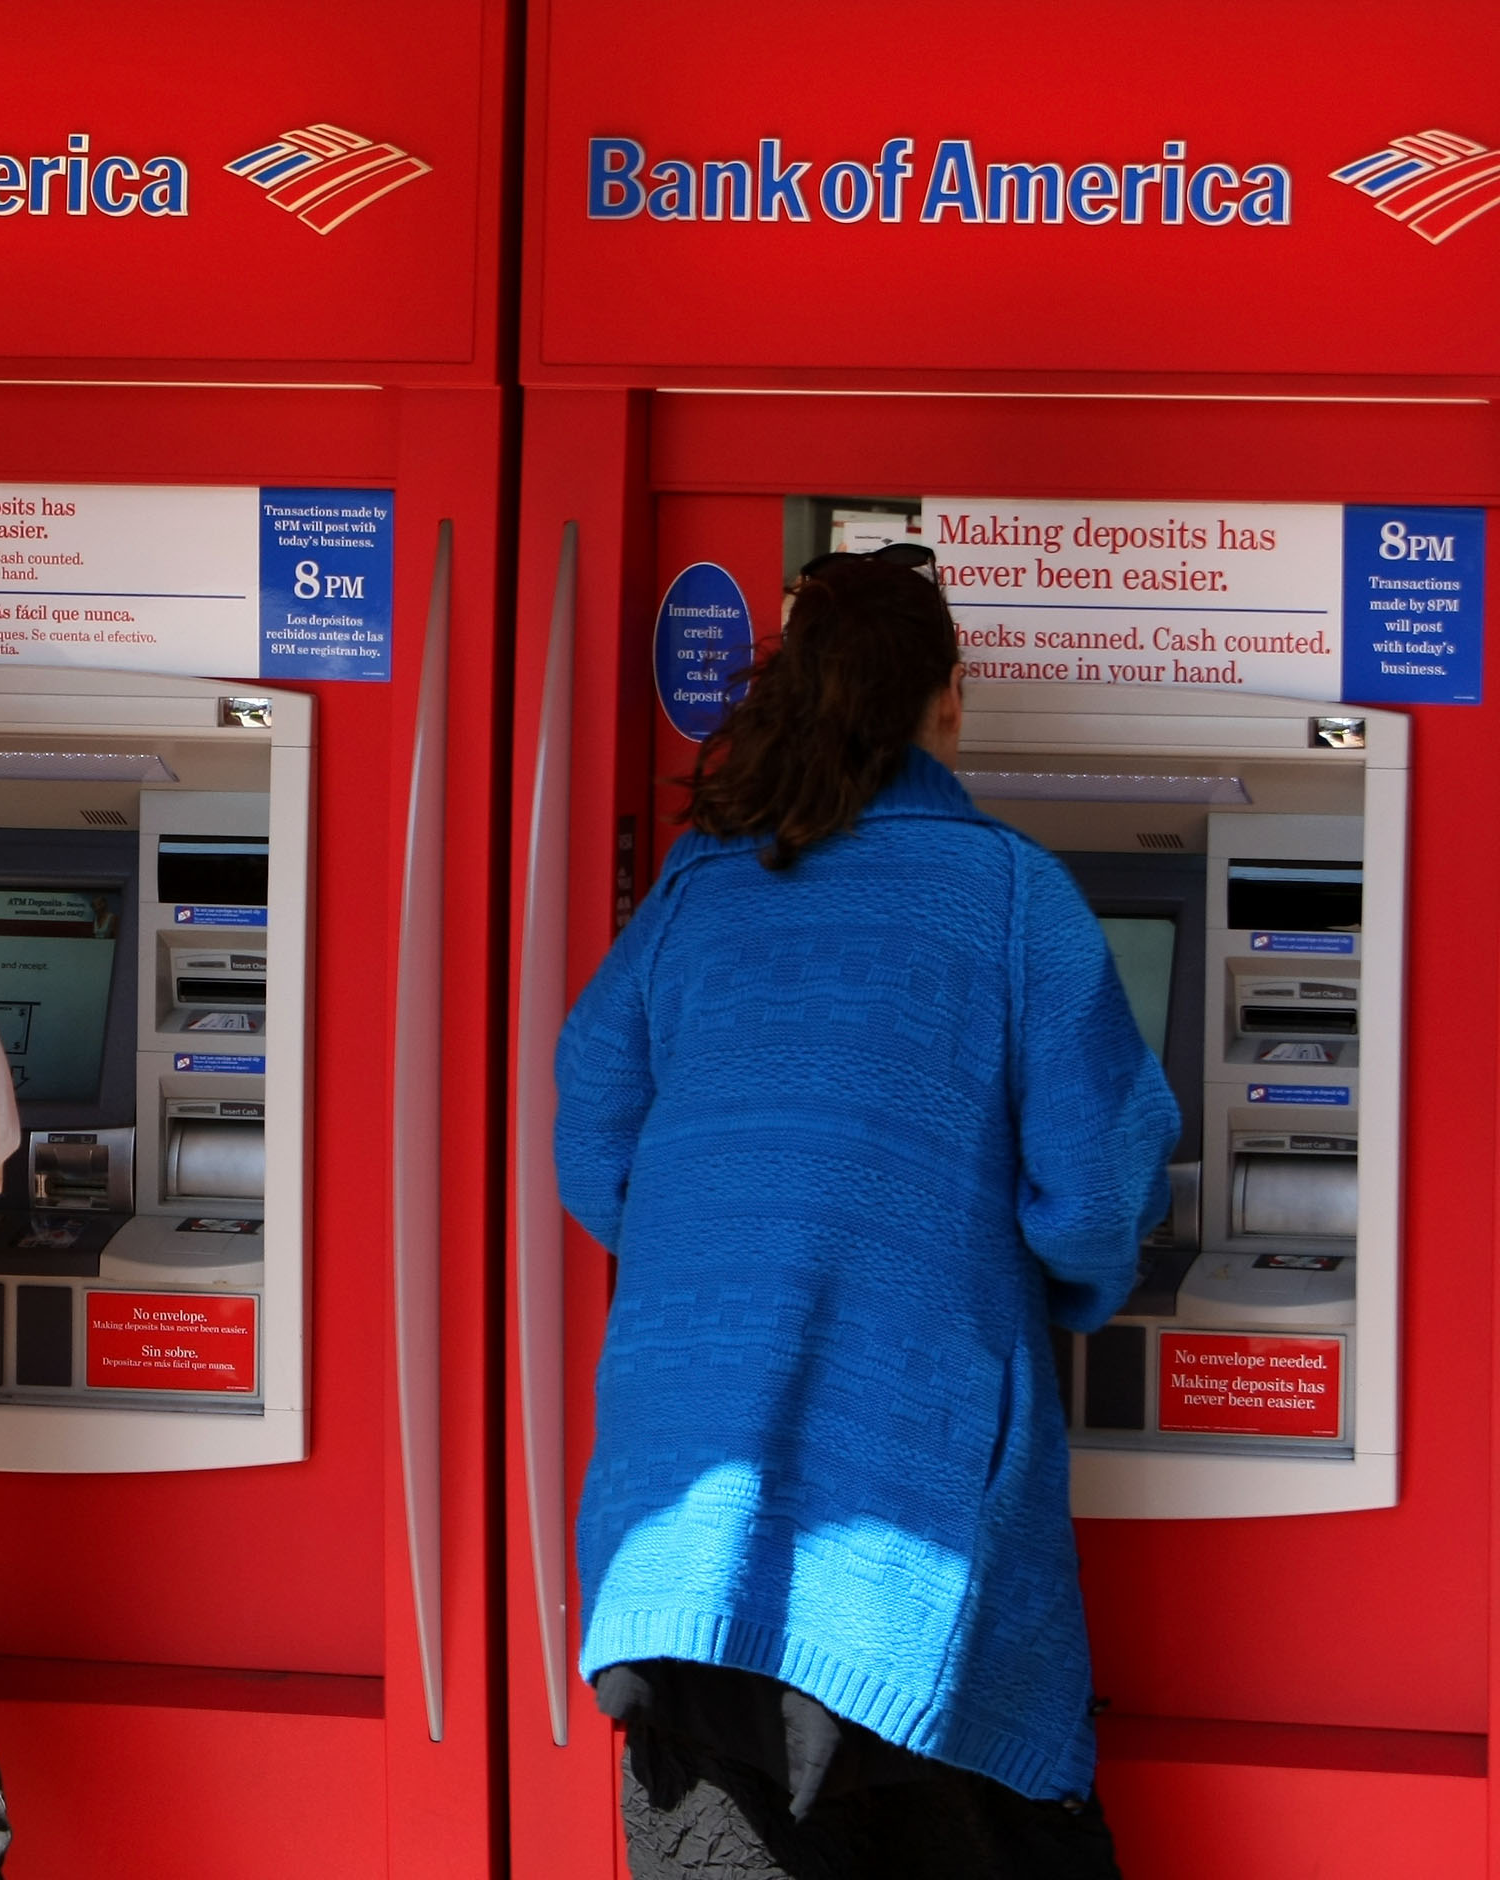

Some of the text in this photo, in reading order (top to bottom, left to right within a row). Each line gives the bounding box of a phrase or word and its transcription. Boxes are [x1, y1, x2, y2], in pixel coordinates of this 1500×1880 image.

[588, 135, 1291, 226] Bank of America
[41, 497, 75, 516] has
[263, 504, 387, 520] Transactions made by
[274, 520, 376, 534] 8PM will post with
[937, 514, 1064, 554] Making
[1073, 516, 1207, 554] deposits
[1217, 519, 1275, 551] has
[278, 535, 375, 549] today's business.
[27, 552, 84, 565] counted.
[2, 566, 38, 580] hand.
[937, 558, 1227, 591] never been easier.
[1368, 576, 1460, 590] Transactions
[16, 604, 47, 620] fácil
[51, 609, 79, 623] que
[84, 610, 134, 622] nunca.
[668, 603, 740, 619] Immediate
[1368, 598, 1459, 613] made by 8PM
[287, 613, 363, 628] Los depósitos
[1384, 619, 1442, 635] will post
[31, 629, 47, 641] Se
[49, 630, 91, 642] cuenta
[93, 629, 105, 642] el
[107, 629, 157, 644] efectivo.
[265, 628, 384, 643] recibidos antes de las
[683, 625, 724, 639] credit
[956, 622, 1330, 655] hecks scanned. Cash counted.
[270, 643, 381, 659] 8PM se registran hoy.
[677, 648, 695, 660] on
[1372, 640, 1454, 656] with today's
[960, 657, 1242, 684] ssurance in your hand.
[1381, 661, 1446, 675] business.
[133, 1308, 208, 1324] No envelope.
[141, 1345, 198, 1358] Sin sobre.
[1172, 1374, 1325, 1394] Making deposits has
[1184, 1393, 1315, 1409] never been easier.
